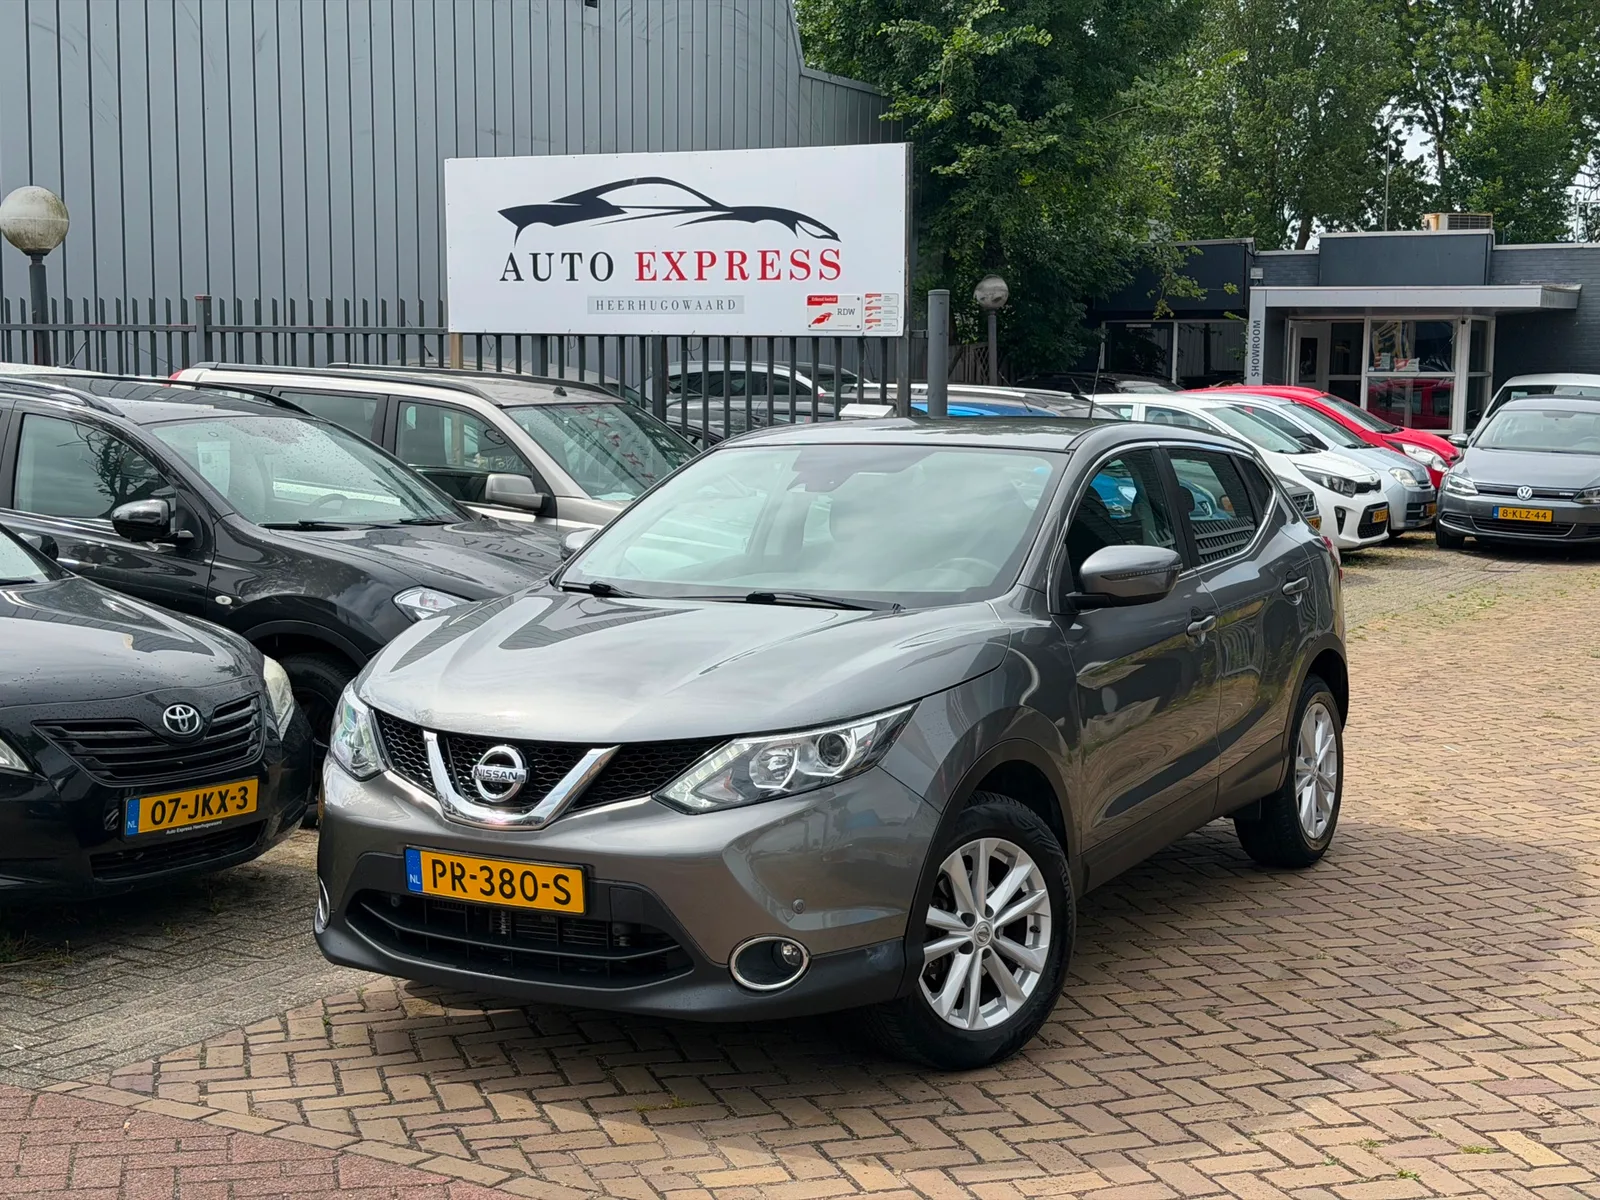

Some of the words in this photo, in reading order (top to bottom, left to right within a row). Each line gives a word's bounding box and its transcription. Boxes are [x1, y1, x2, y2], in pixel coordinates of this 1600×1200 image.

[500, 252, 614, 282] AUTO
[635, 249, 841, 282] EXPRESS
[595, 299, 737, 311] HEERHUGOWAARD
[837, 308, 856, 316] RDW
[1251, 320, 1261, 377] SHOWROOM
[1502, 508, 1547, 520] 8-KLZ-44
[474, 766, 518, 781] NISSAN
[150, 786, 249, 826] 07-JKX-3
[127, 820, 138, 829] NL
[409, 873, 421, 885] NL
[431, 859, 571, 905] PR-380-S
